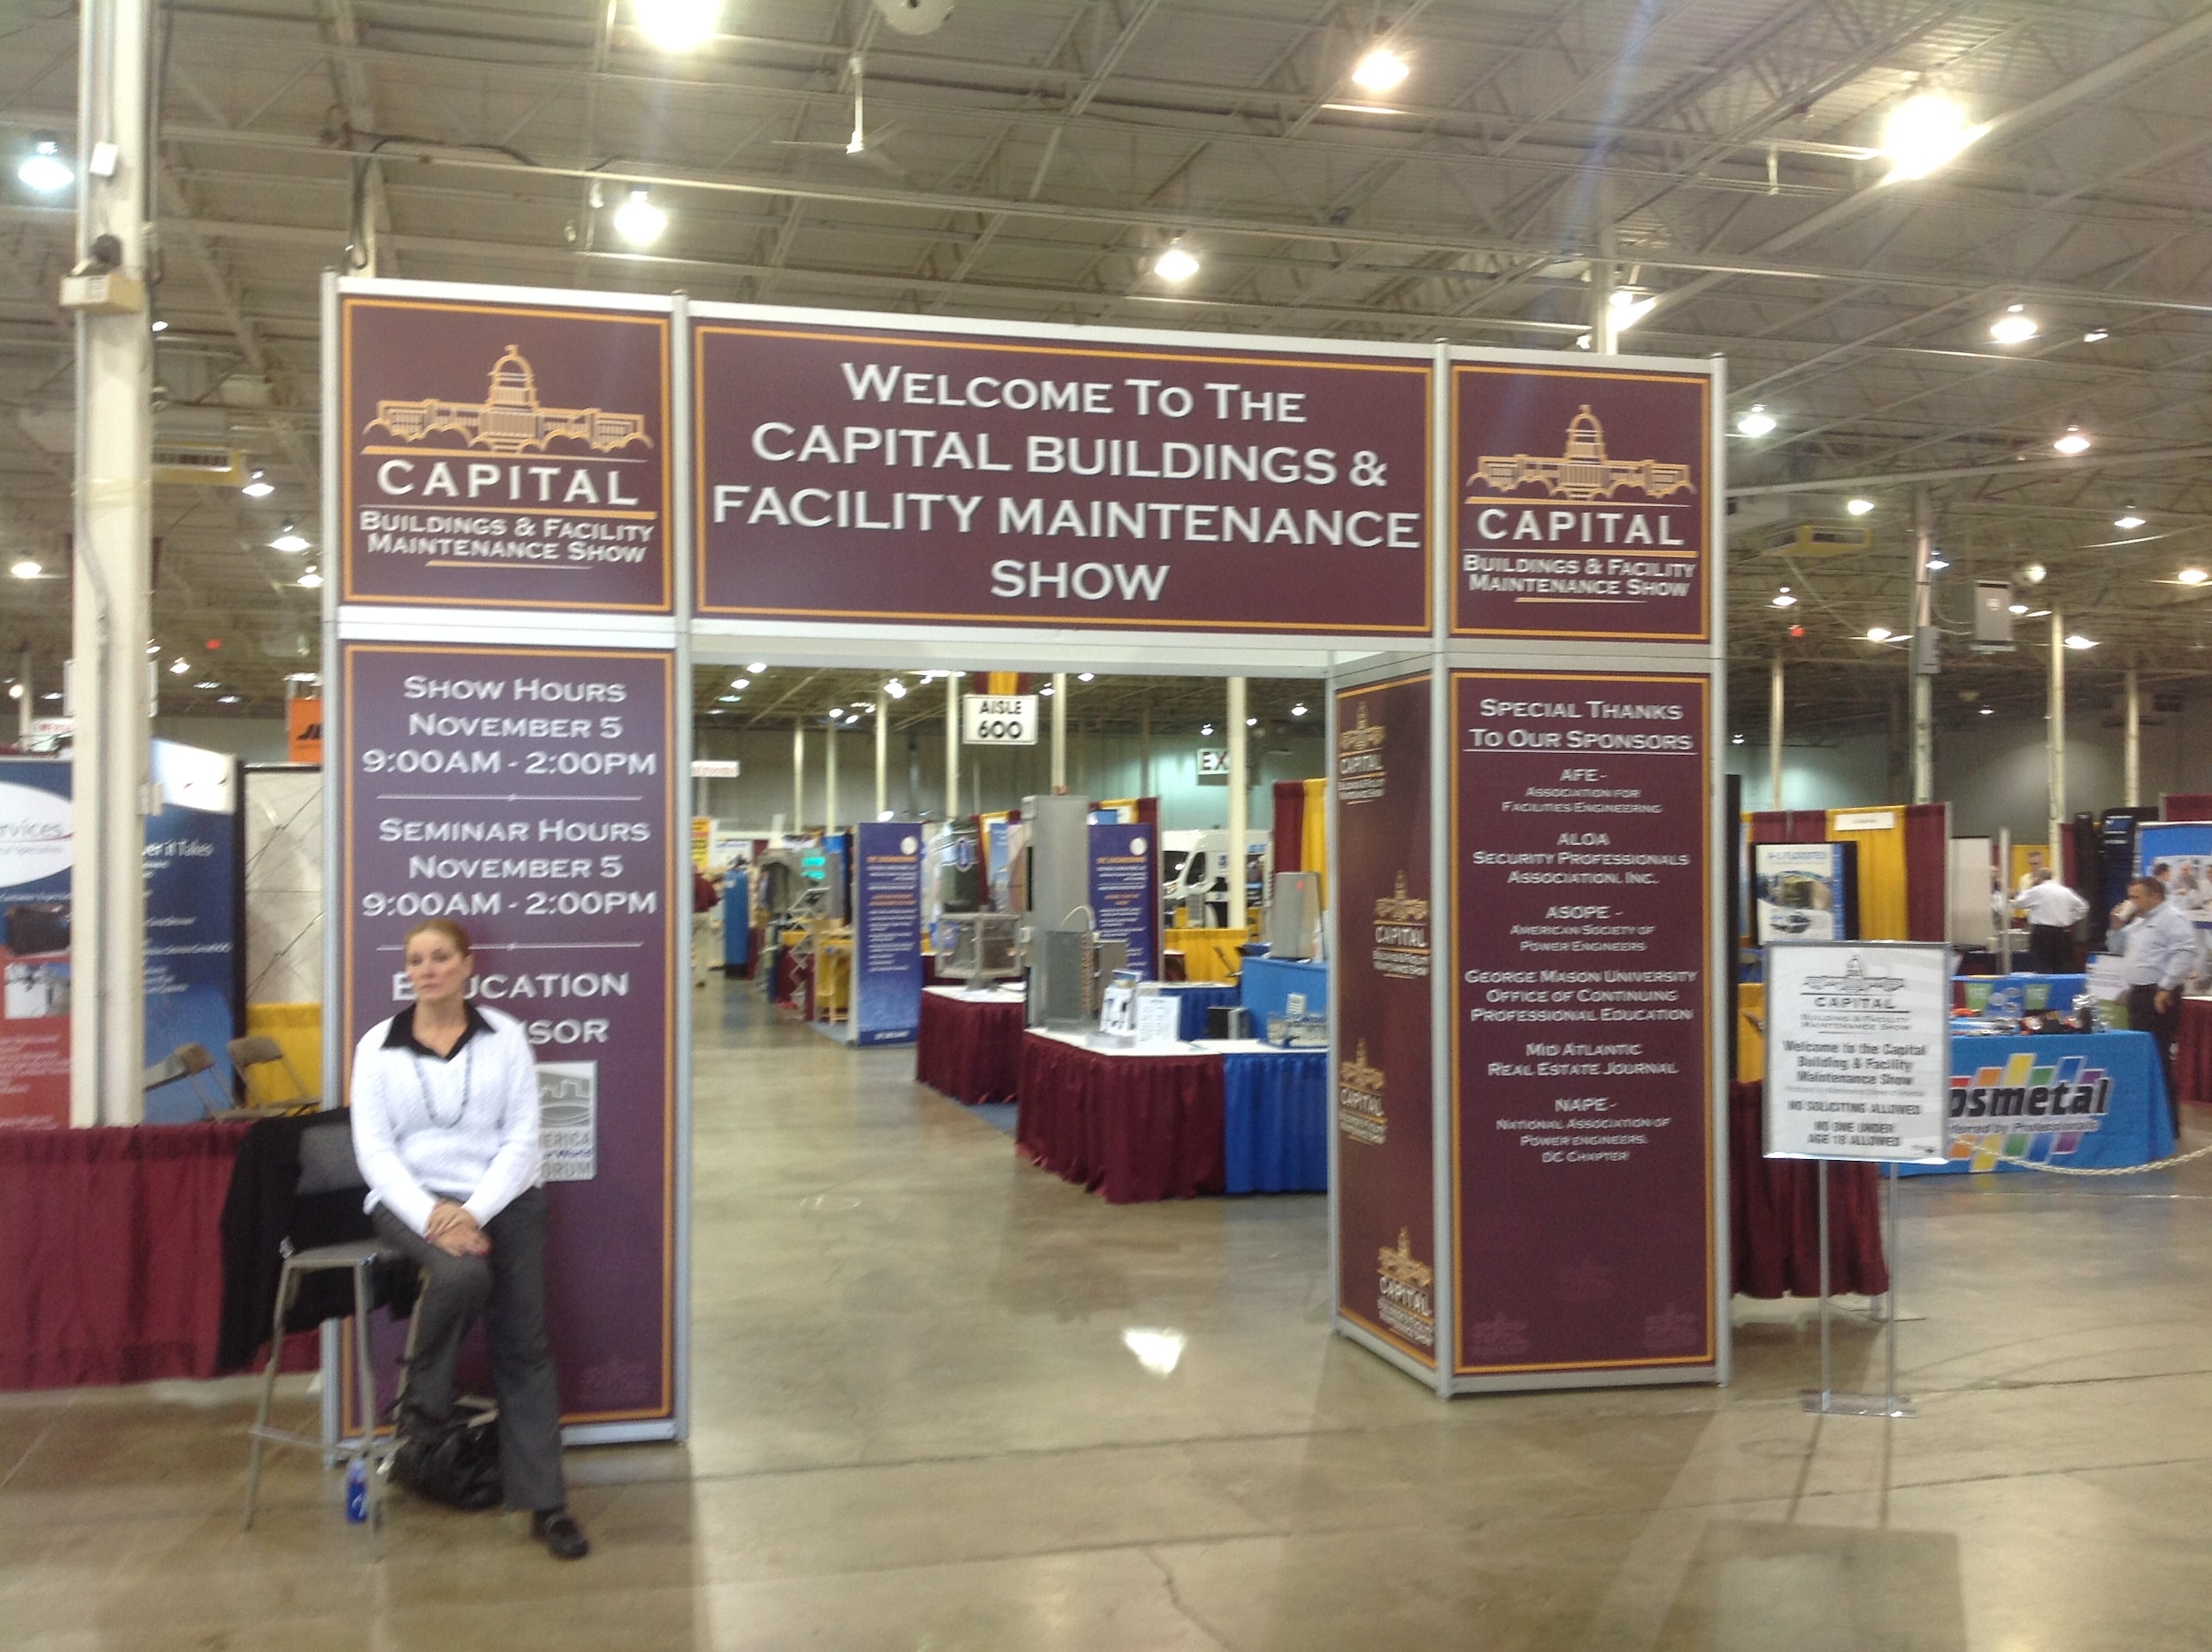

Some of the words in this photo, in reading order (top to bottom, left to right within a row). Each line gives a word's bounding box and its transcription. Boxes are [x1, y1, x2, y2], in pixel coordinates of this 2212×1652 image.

[840, 361, 1114, 415] WELCOME
[1124, 378, 1194, 419] TO
[1203, 381, 1307, 424] THE
[751, 420, 1012, 472] CAPITAL
[1025, 435, 1337, 486] BUILDINGS
[1348, 449, 1388, 488] &
[377, 459, 639, 506] CAPITAL
[712, 484, 984, 534] FACILITY
[997, 497, 1421, 549] MAINTENANCE
[359, 511, 507, 535] BUILDINGS
[513, 517, 535, 538] &
[542, 519, 655, 542] FACILITY
[1477, 508, 1686, 546] CAPITAL
[367, 533, 559, 560] MAINTENANCE
[567, 541, 648, 564] SHOW
[1463, 554, 1581, 574] BUILDINGS
[1584, 558, 1603, 574] &
[1608, 558, 1697, 578] FACILITY
[989, 559, 1171, 603] SHOW
[1469, 573, 1622, 595] MAINTENANCE
[1625, 579, 1691, 597] SHOW
[403, 675, 505, 702] SHOW
[513, 678, 628, 703] HOURS
[979, 700, 1022, 715] AISLE
[1479, 698, 1583, 718] SPECIAL
[1586, 701, 1684, 720] THANKS
[409, 712, 592, 739] NOVEMBER
[599, 716, 624, 739] 5
[978, 720, 1023, 739] 600
[1469, 728, 1503, 748] TO
[1508, 729, 1562, 749] OUR
[1566, 730, 1694, 750] SPONSORS
[362, 749, 502, 774] 9:00AM
[524, 751, 658, 776] 2:00PM
[1202, 752, 1228, 771] EX
[1340, 753, 1384, 774] CAPITAL
[1574, 802, 1663, 813] ENGINEERING
[379, 817, 530, 842] SEMINAR
[537, 818, 652, 842] HOURS
[1556, 833, 1611, 846] ALOA
[409, 854, 593, 880] NOVEMBER
[599, 855, 624, 879] 5
[1472, 851, 1555, 864] SECURITY
[1557, 851, 1692, 866] PROFESSIONALS
[362, 891, 502, 918] 9:00AM
[524, 890, 658, 915] 2:00PM
[1545, 905, 1611, 919] ASOPE
[1376, 926, 1428, 947] CAPITAL
[1509, 924, 1580, 936] AMERICAN
[1582, 924, 1636, 935] SOCIETY
[1520, 941, 1570, 952] POWER
[1571, 941, 1647, 952] ENGINEERS
[1464, 969, 1539, 984] GEORGE
[1540, 970, 1603, 984] MASON
[1604, 969, 1699, 983] UNIVERSITY
[392, 972, 630, 1002] EUCATION
[1486, 987, 1549, 1003] OFFICE
[1551, 990, 1576, 1003] OF
[1576, 987, 1679, 1003] CONTINUING
[1814, 997, 1895, 1009] CAPITAL
[1471, 1008, 1598, 1022] PROFESSIONAL
[1600, 1008, 1694, 1021] EDUCATION
[524, 1018, 610, 1045] SOR
[1525, 1043, 1561, 1057] MID
[1562, 1042, 1643, 1057] ATLANTIC
[1783, 1041, 1839, 1053] Welcome
[1842, 1042, 1855, 1054] to
[1859, 1042, 1880, 1054] the
[1883, 1043, 1927, 1057] Capital
[1487, 1063, 1535, 1077] REAL
[1537, 1063, 1600, 1076] ESTATE
[1602, 1062, 1680, 1075] JOURNAL
[1797, 1056, 1847, 1070] Building
[1866, 1058, 1914, 1072] Facility
[1796, 1071, 1877, 1085] Maintenance
[1878, 1072, 1914, 1086] Show
[1555, 1098, 1609, 1112] NAPE
[1787, 1101, 1802, 1110] NO
[1870, 1104, 1922, 1115] ALLOWED
[1496, 1118, 1564, 1130] NATIONAL
[1566, 1118, 1652, 1130] ASSOCIATION
[1815, 1121, 1828, 1132] NO
[1833, 1122, 1854, 1133] ONE
[1858, 1123, 1894, 1133] UNDER
[1520, 1134, 1571, 1147] POWER
[1808, 1133, 1830, 1144] AGE
[1849, 1136, 1901, 1147] ALLOWED
[1541, 1151, 1565, 1163] DC
[1566, 1151, 1630, 1163] CHAPTER
